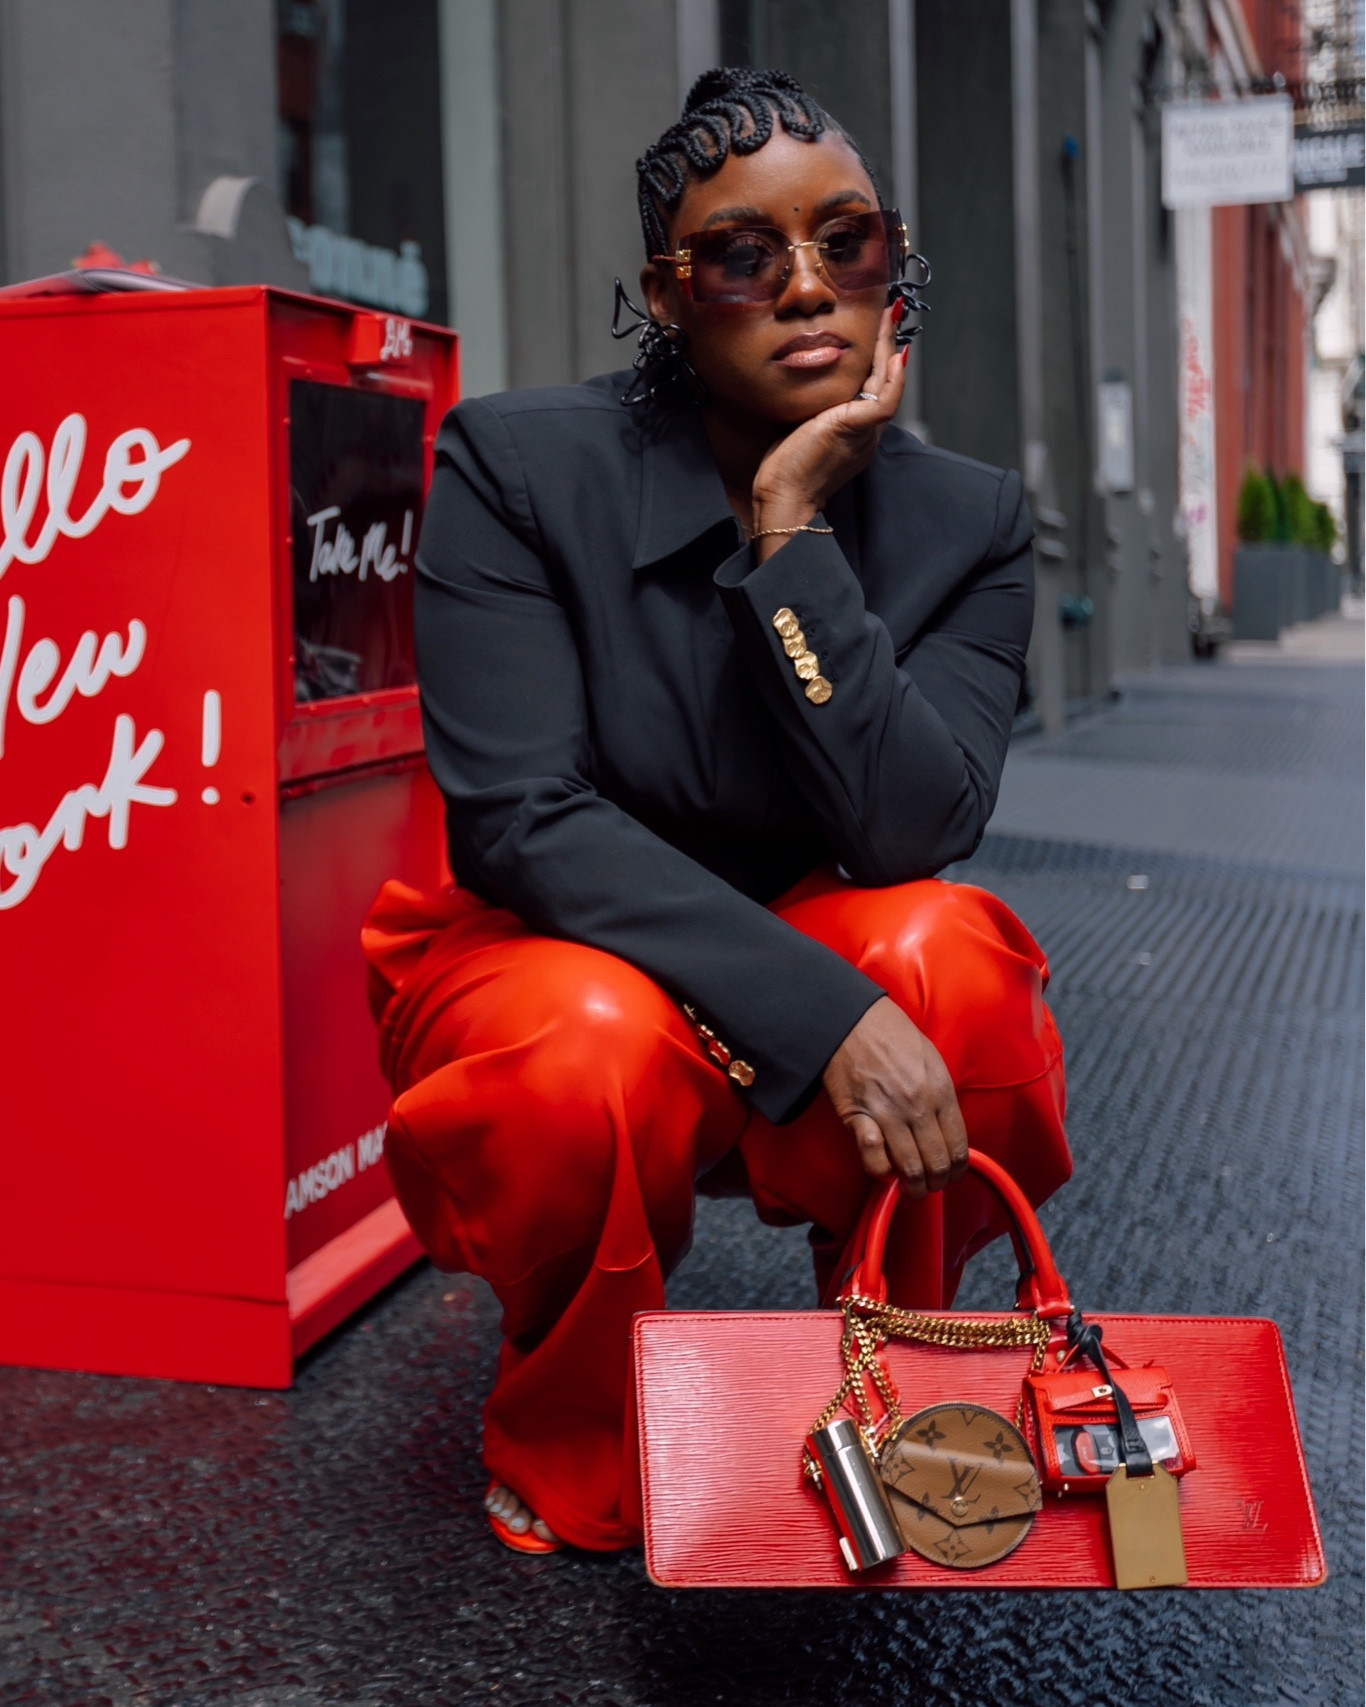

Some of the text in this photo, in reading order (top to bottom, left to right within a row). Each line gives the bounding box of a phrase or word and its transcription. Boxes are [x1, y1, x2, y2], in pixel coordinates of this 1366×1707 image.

[306, 505, 413, 583] Take Me!
[358, 1119, 388, 1171] MA
